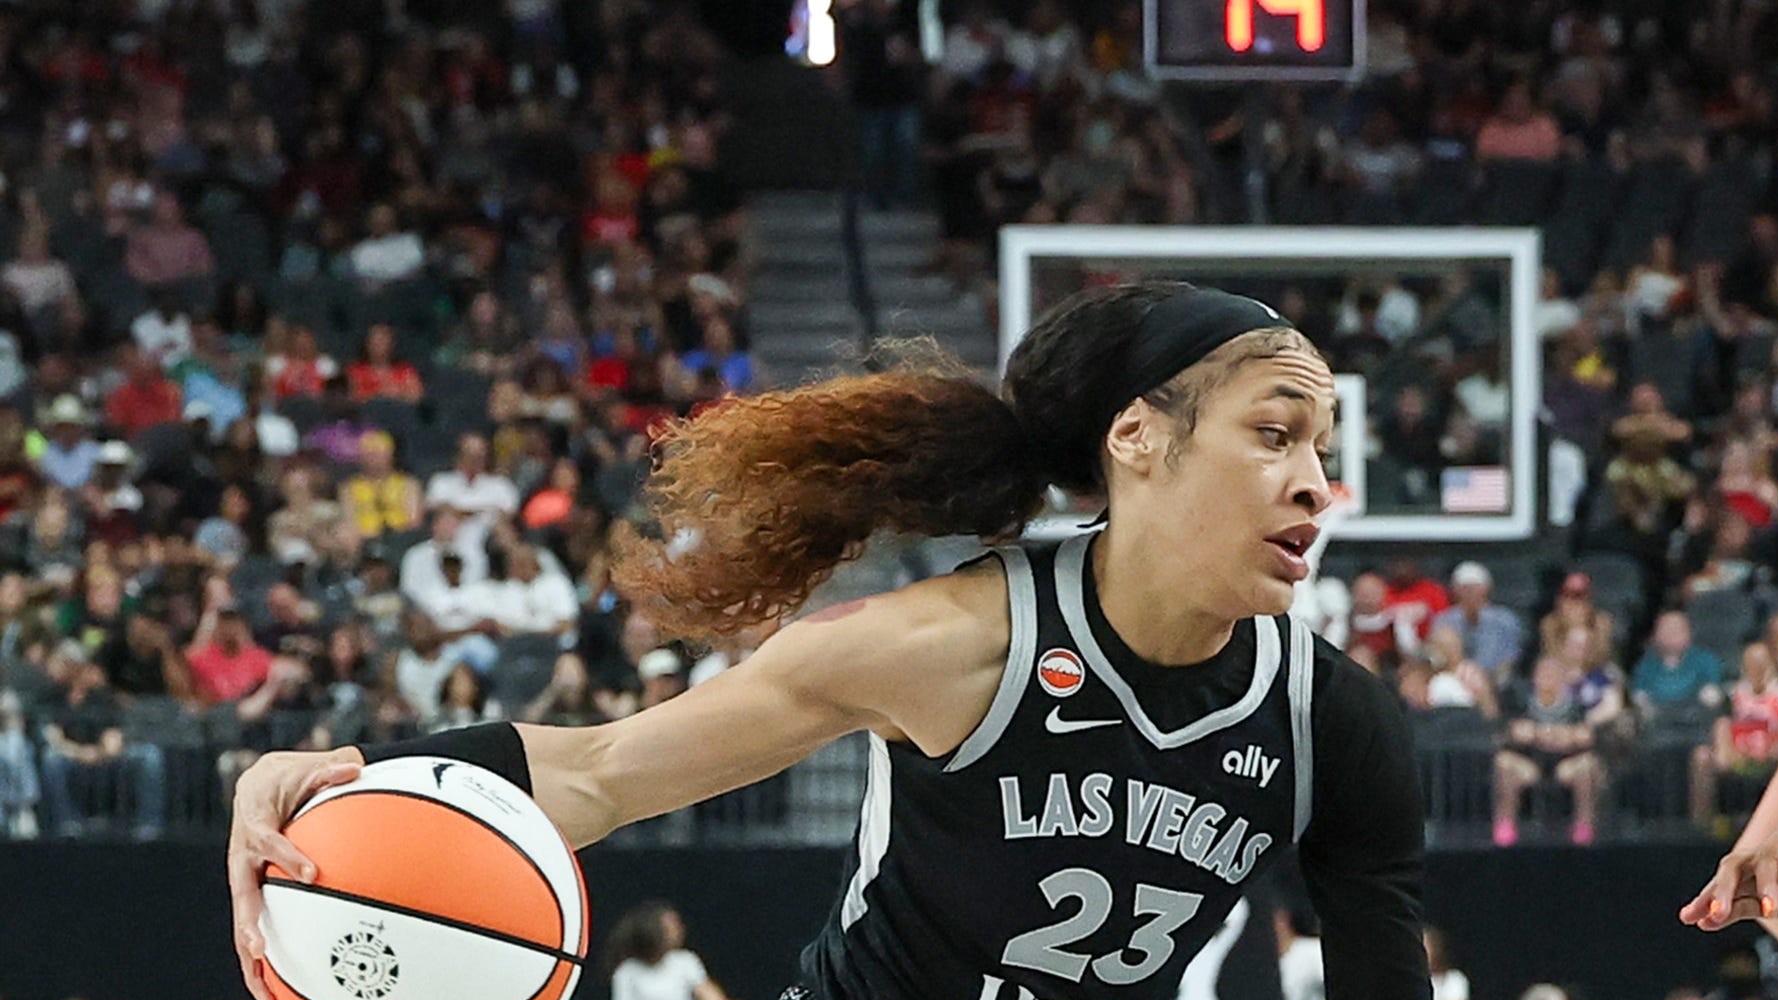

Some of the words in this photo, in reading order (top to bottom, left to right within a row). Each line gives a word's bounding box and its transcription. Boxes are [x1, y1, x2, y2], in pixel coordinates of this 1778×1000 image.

[1222, 744, 1281, 788] ally
[999, 773, 1114, 840] LAS
[1126, 778, 1273, 884] VEGAS
[1000, 867, 1205, 985] 23
